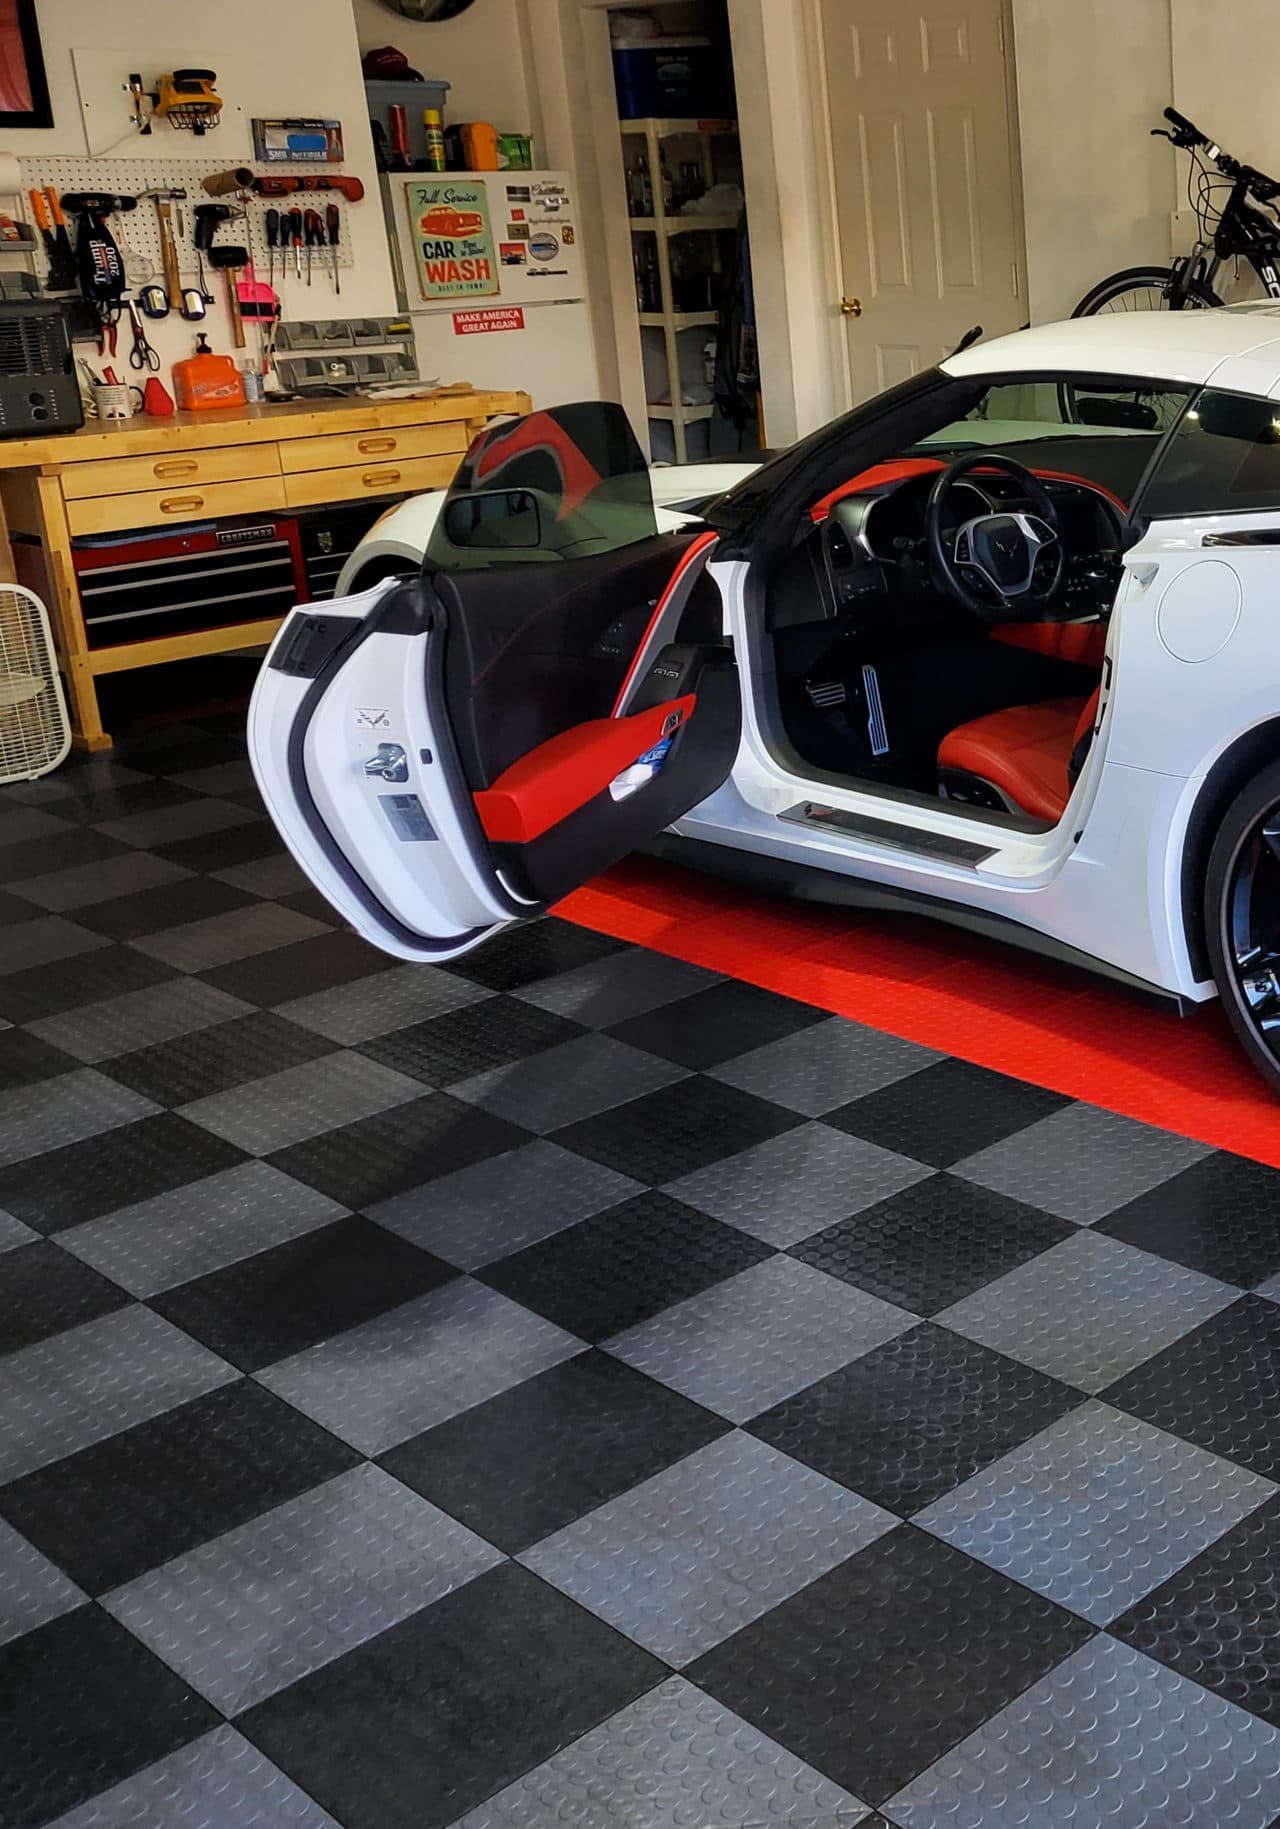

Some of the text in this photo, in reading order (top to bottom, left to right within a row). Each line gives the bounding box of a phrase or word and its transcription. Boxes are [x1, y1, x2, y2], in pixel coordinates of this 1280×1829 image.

[416, 187, 478, 205] Full Service
[422, 240, 457, 260] CAR
[89, 240, 107, 285] Trump
[105, 247, 120, 276] 2020
[425, 258, 491, 284] WASH
[456, 309, 520, 324] MAKE AMERICA
[462, 319, 518, 333] GREAT AGAIN
[220, 528, 272, 543] CRAFTSMAN
